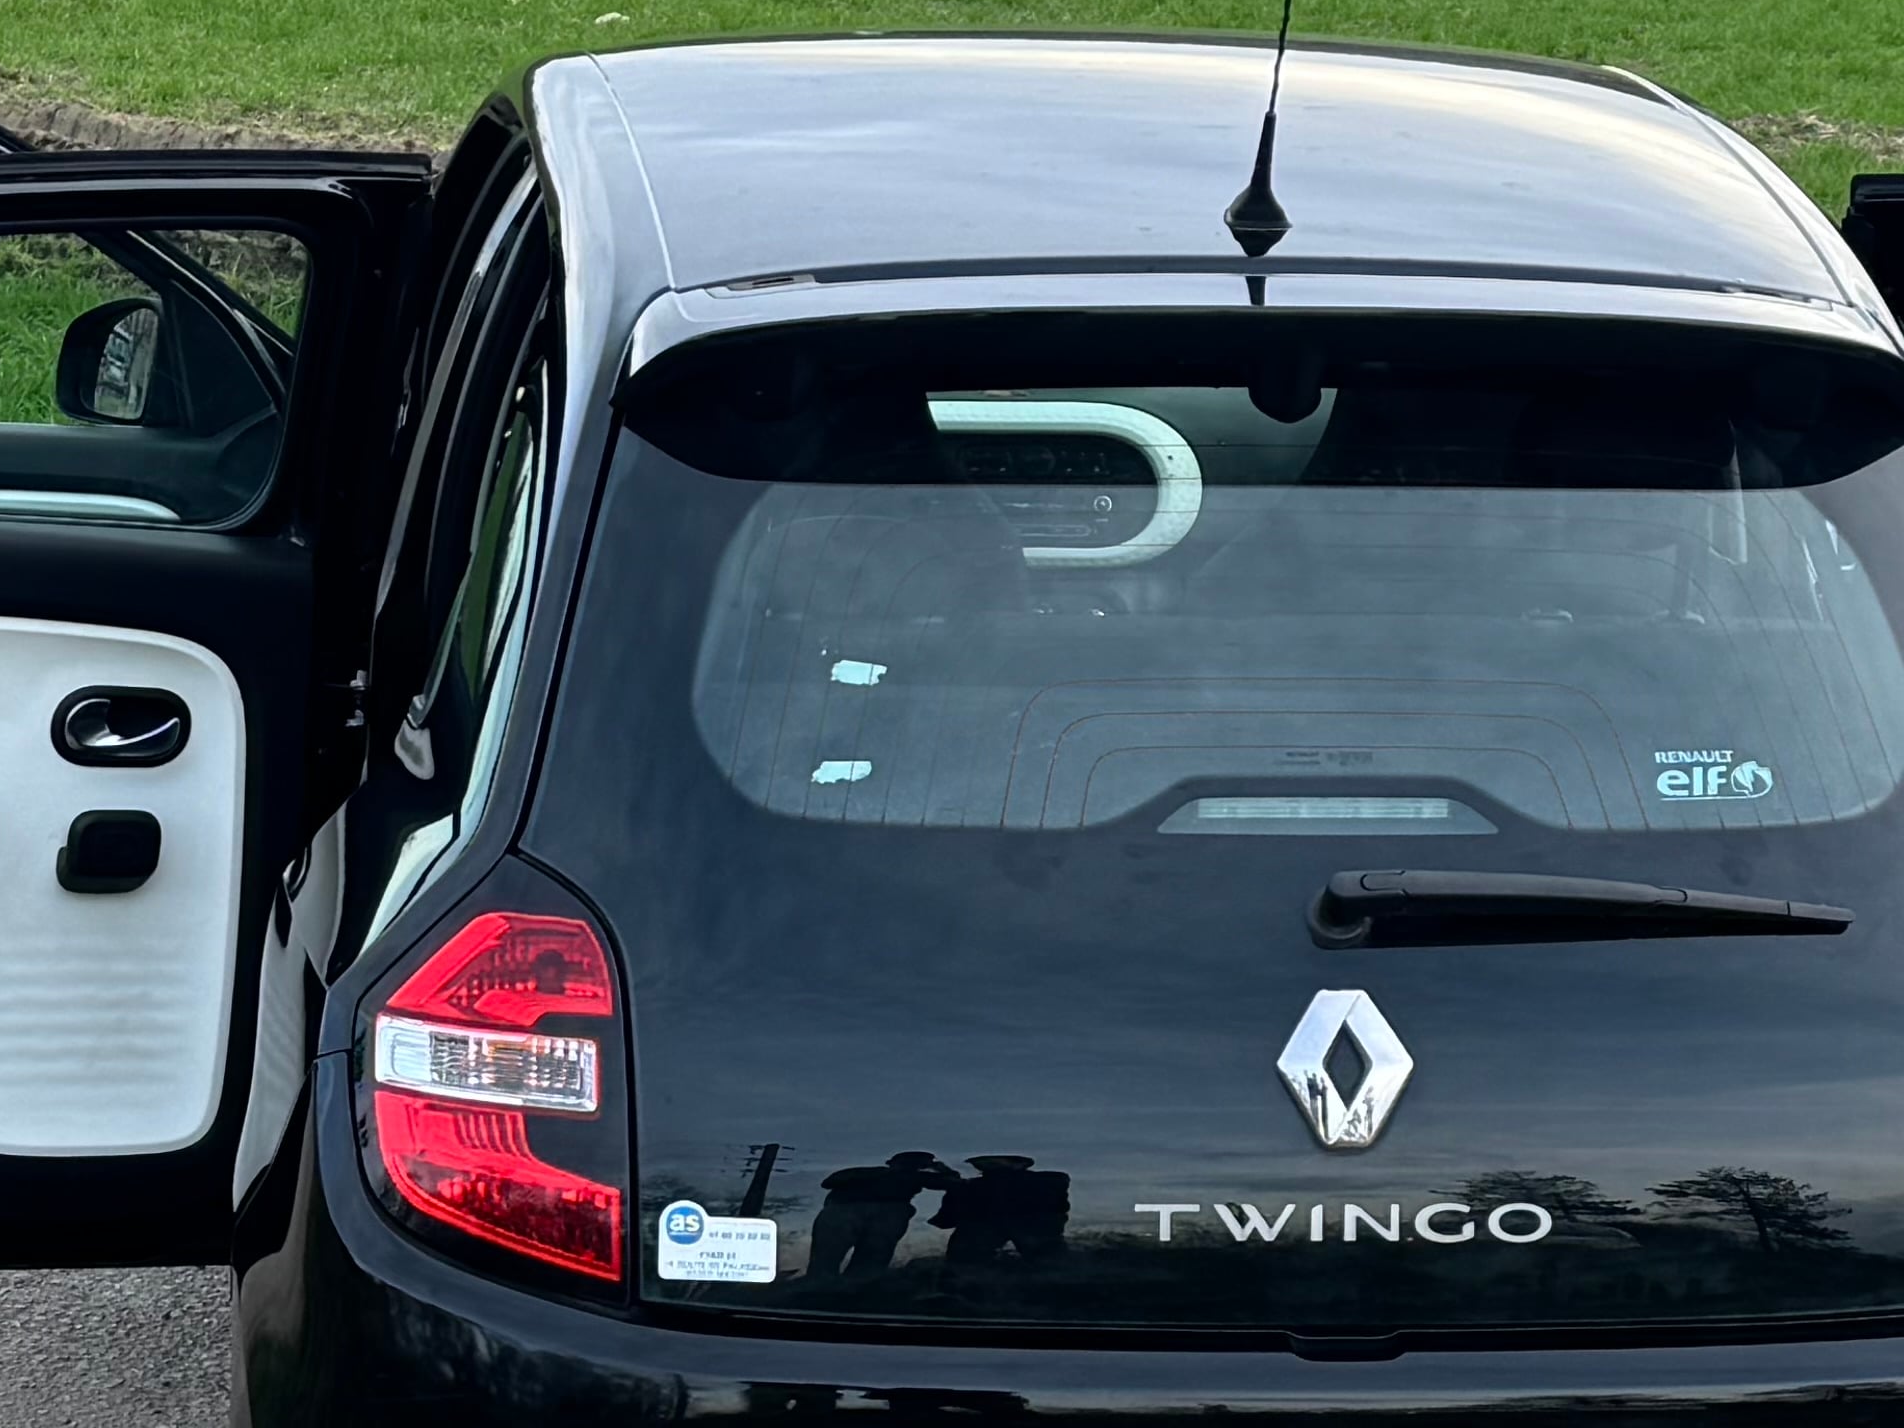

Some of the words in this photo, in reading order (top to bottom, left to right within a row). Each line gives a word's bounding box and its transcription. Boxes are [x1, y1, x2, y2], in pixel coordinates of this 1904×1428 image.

[1654, 750, 1734, 763] RENAULT
[1656, 765, 1728, 796] elf
[668, 1213, 701, 1232] as
[1134, 1202, 1553, 1244] TWINGO
